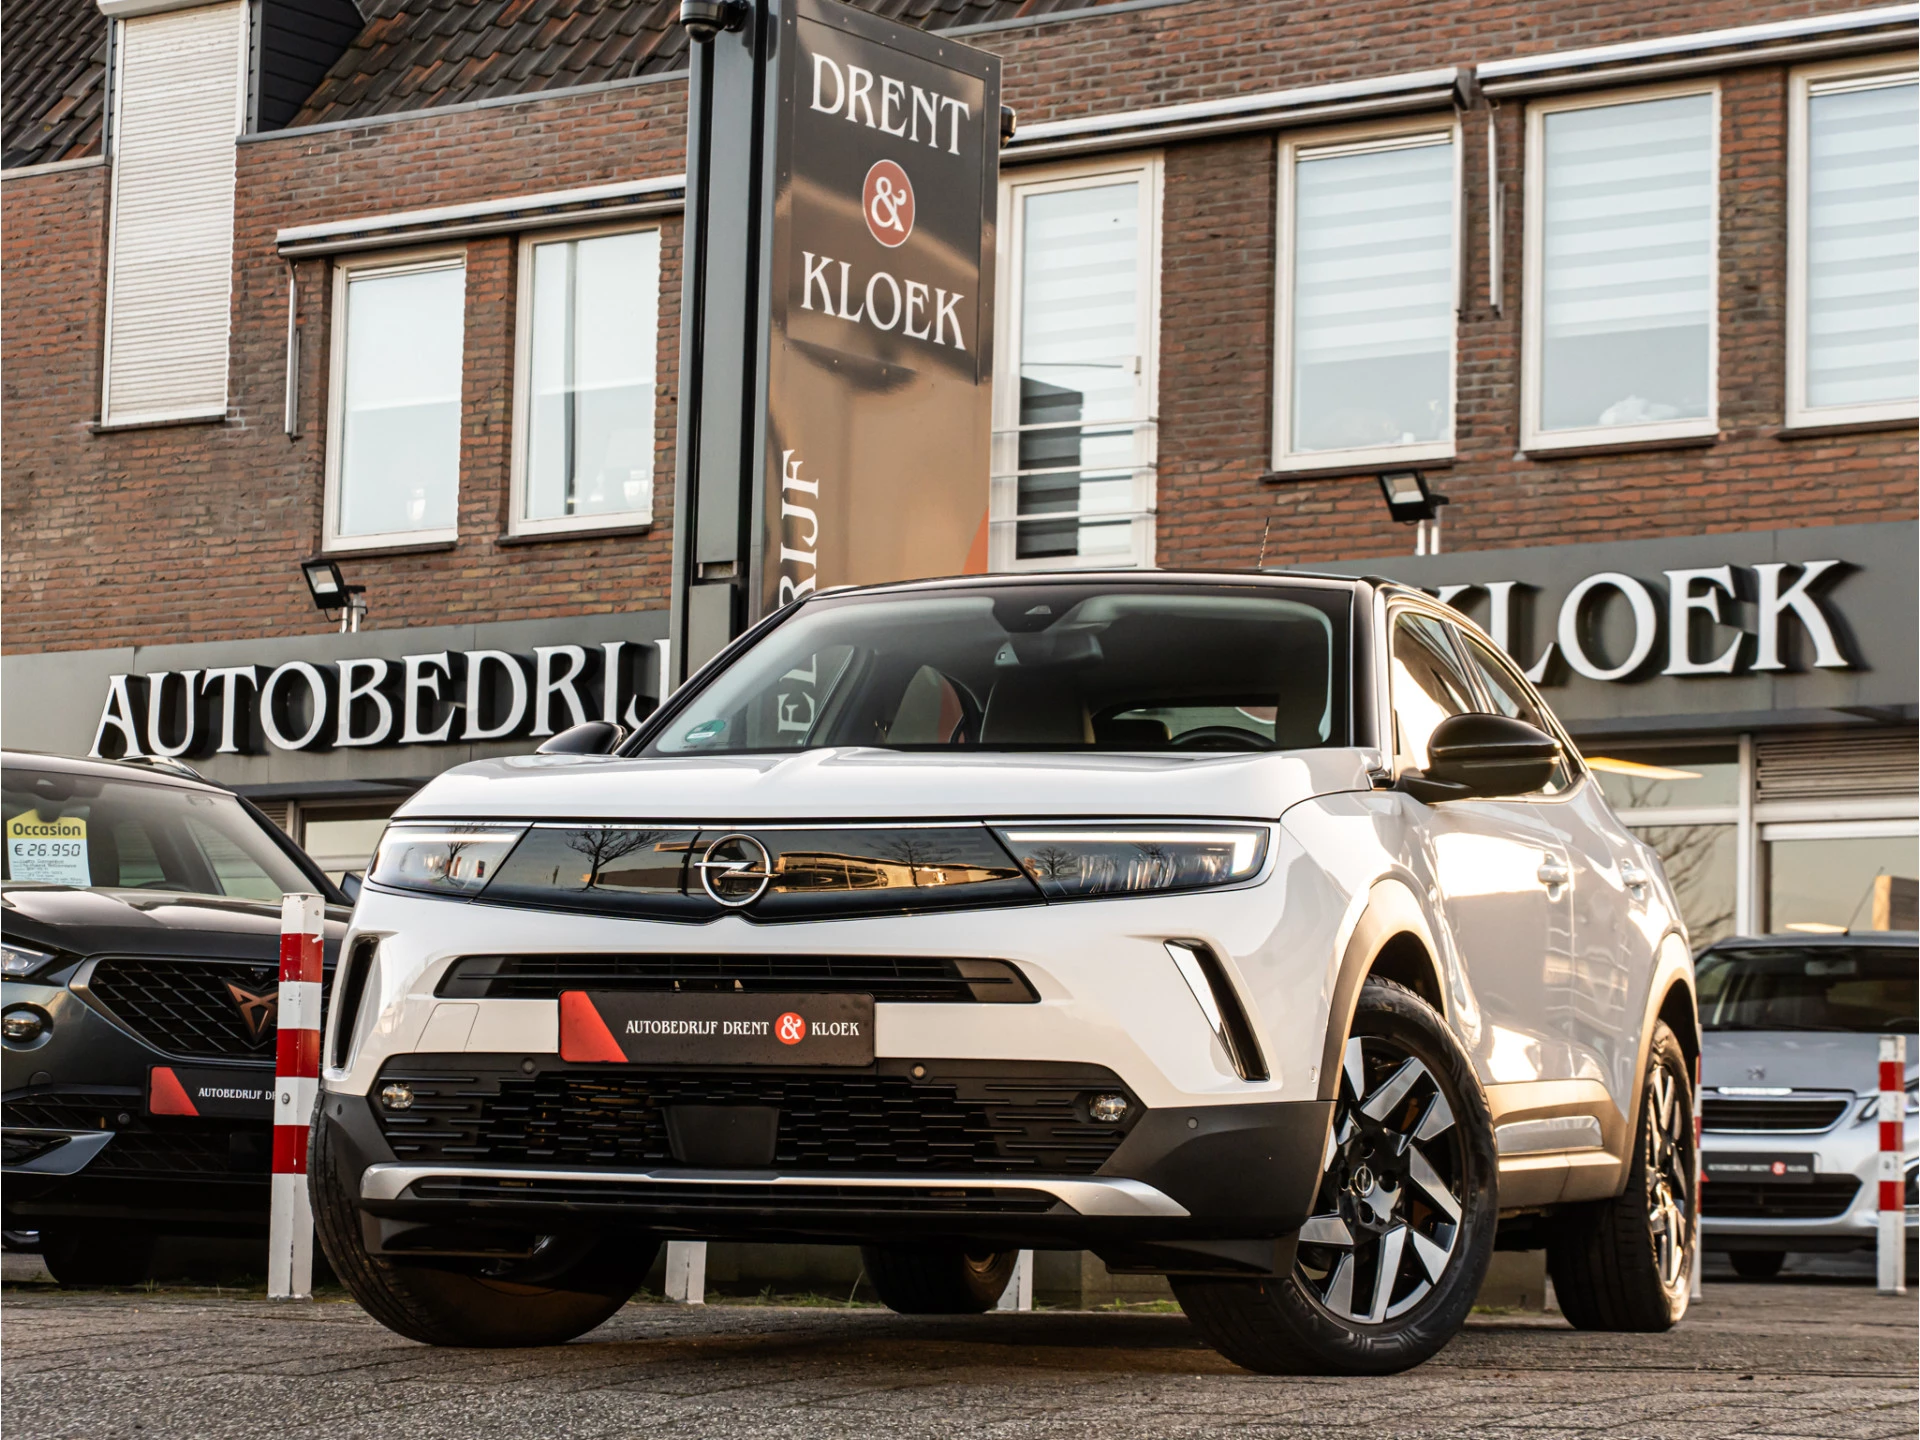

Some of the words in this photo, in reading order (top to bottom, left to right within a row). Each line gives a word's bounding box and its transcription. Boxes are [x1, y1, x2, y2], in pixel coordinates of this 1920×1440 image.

[811, 52, 971, 155] DRENT
[871, 176, 907, 232] &
[801, 251, 966, 350] KLOEK
[1419, 560, 1848, 683] LOEK
[13, 823, 81, 836] Occasion
[14, 844, 24, 856] €
[626, 1020, 718, 1035] AUTOBEDRIJF
[723, 1021, 770, 1036] DRENT
[780, 1015, 802, 1040] &
[811, 1022, 860, 1036] KLOEK
[198, 1087, 262, 1100] AUTOBEDRIJF
